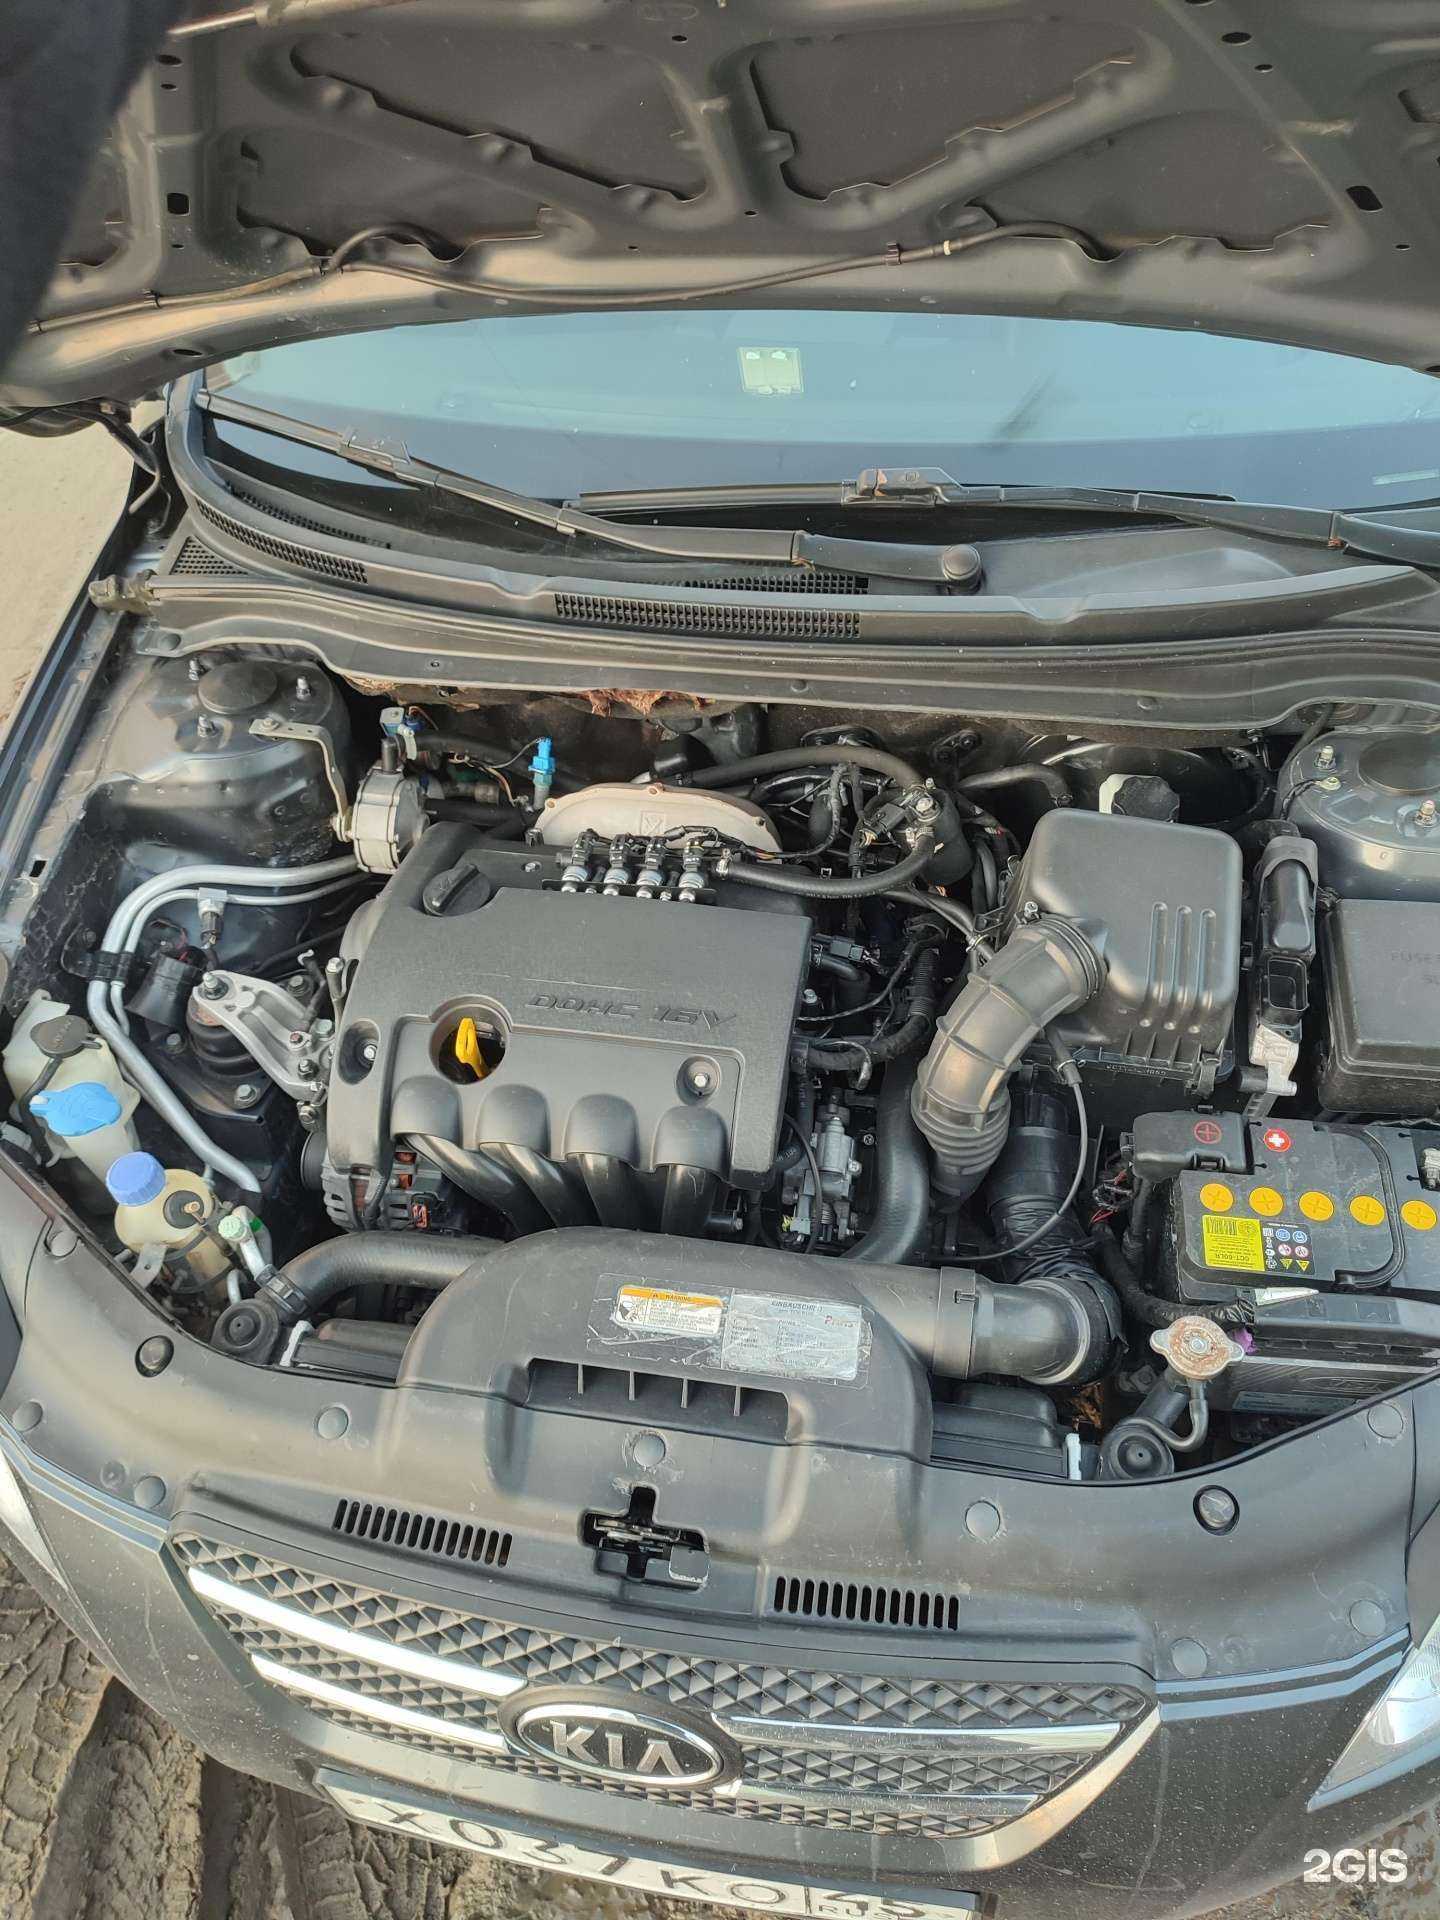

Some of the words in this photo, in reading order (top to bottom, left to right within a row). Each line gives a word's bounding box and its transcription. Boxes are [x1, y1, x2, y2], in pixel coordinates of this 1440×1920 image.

[528, 993, 641, 1019] DOHC
[653, 1006, 737, 1032] 16V
[549, 1718, 688, 1778] KIA
